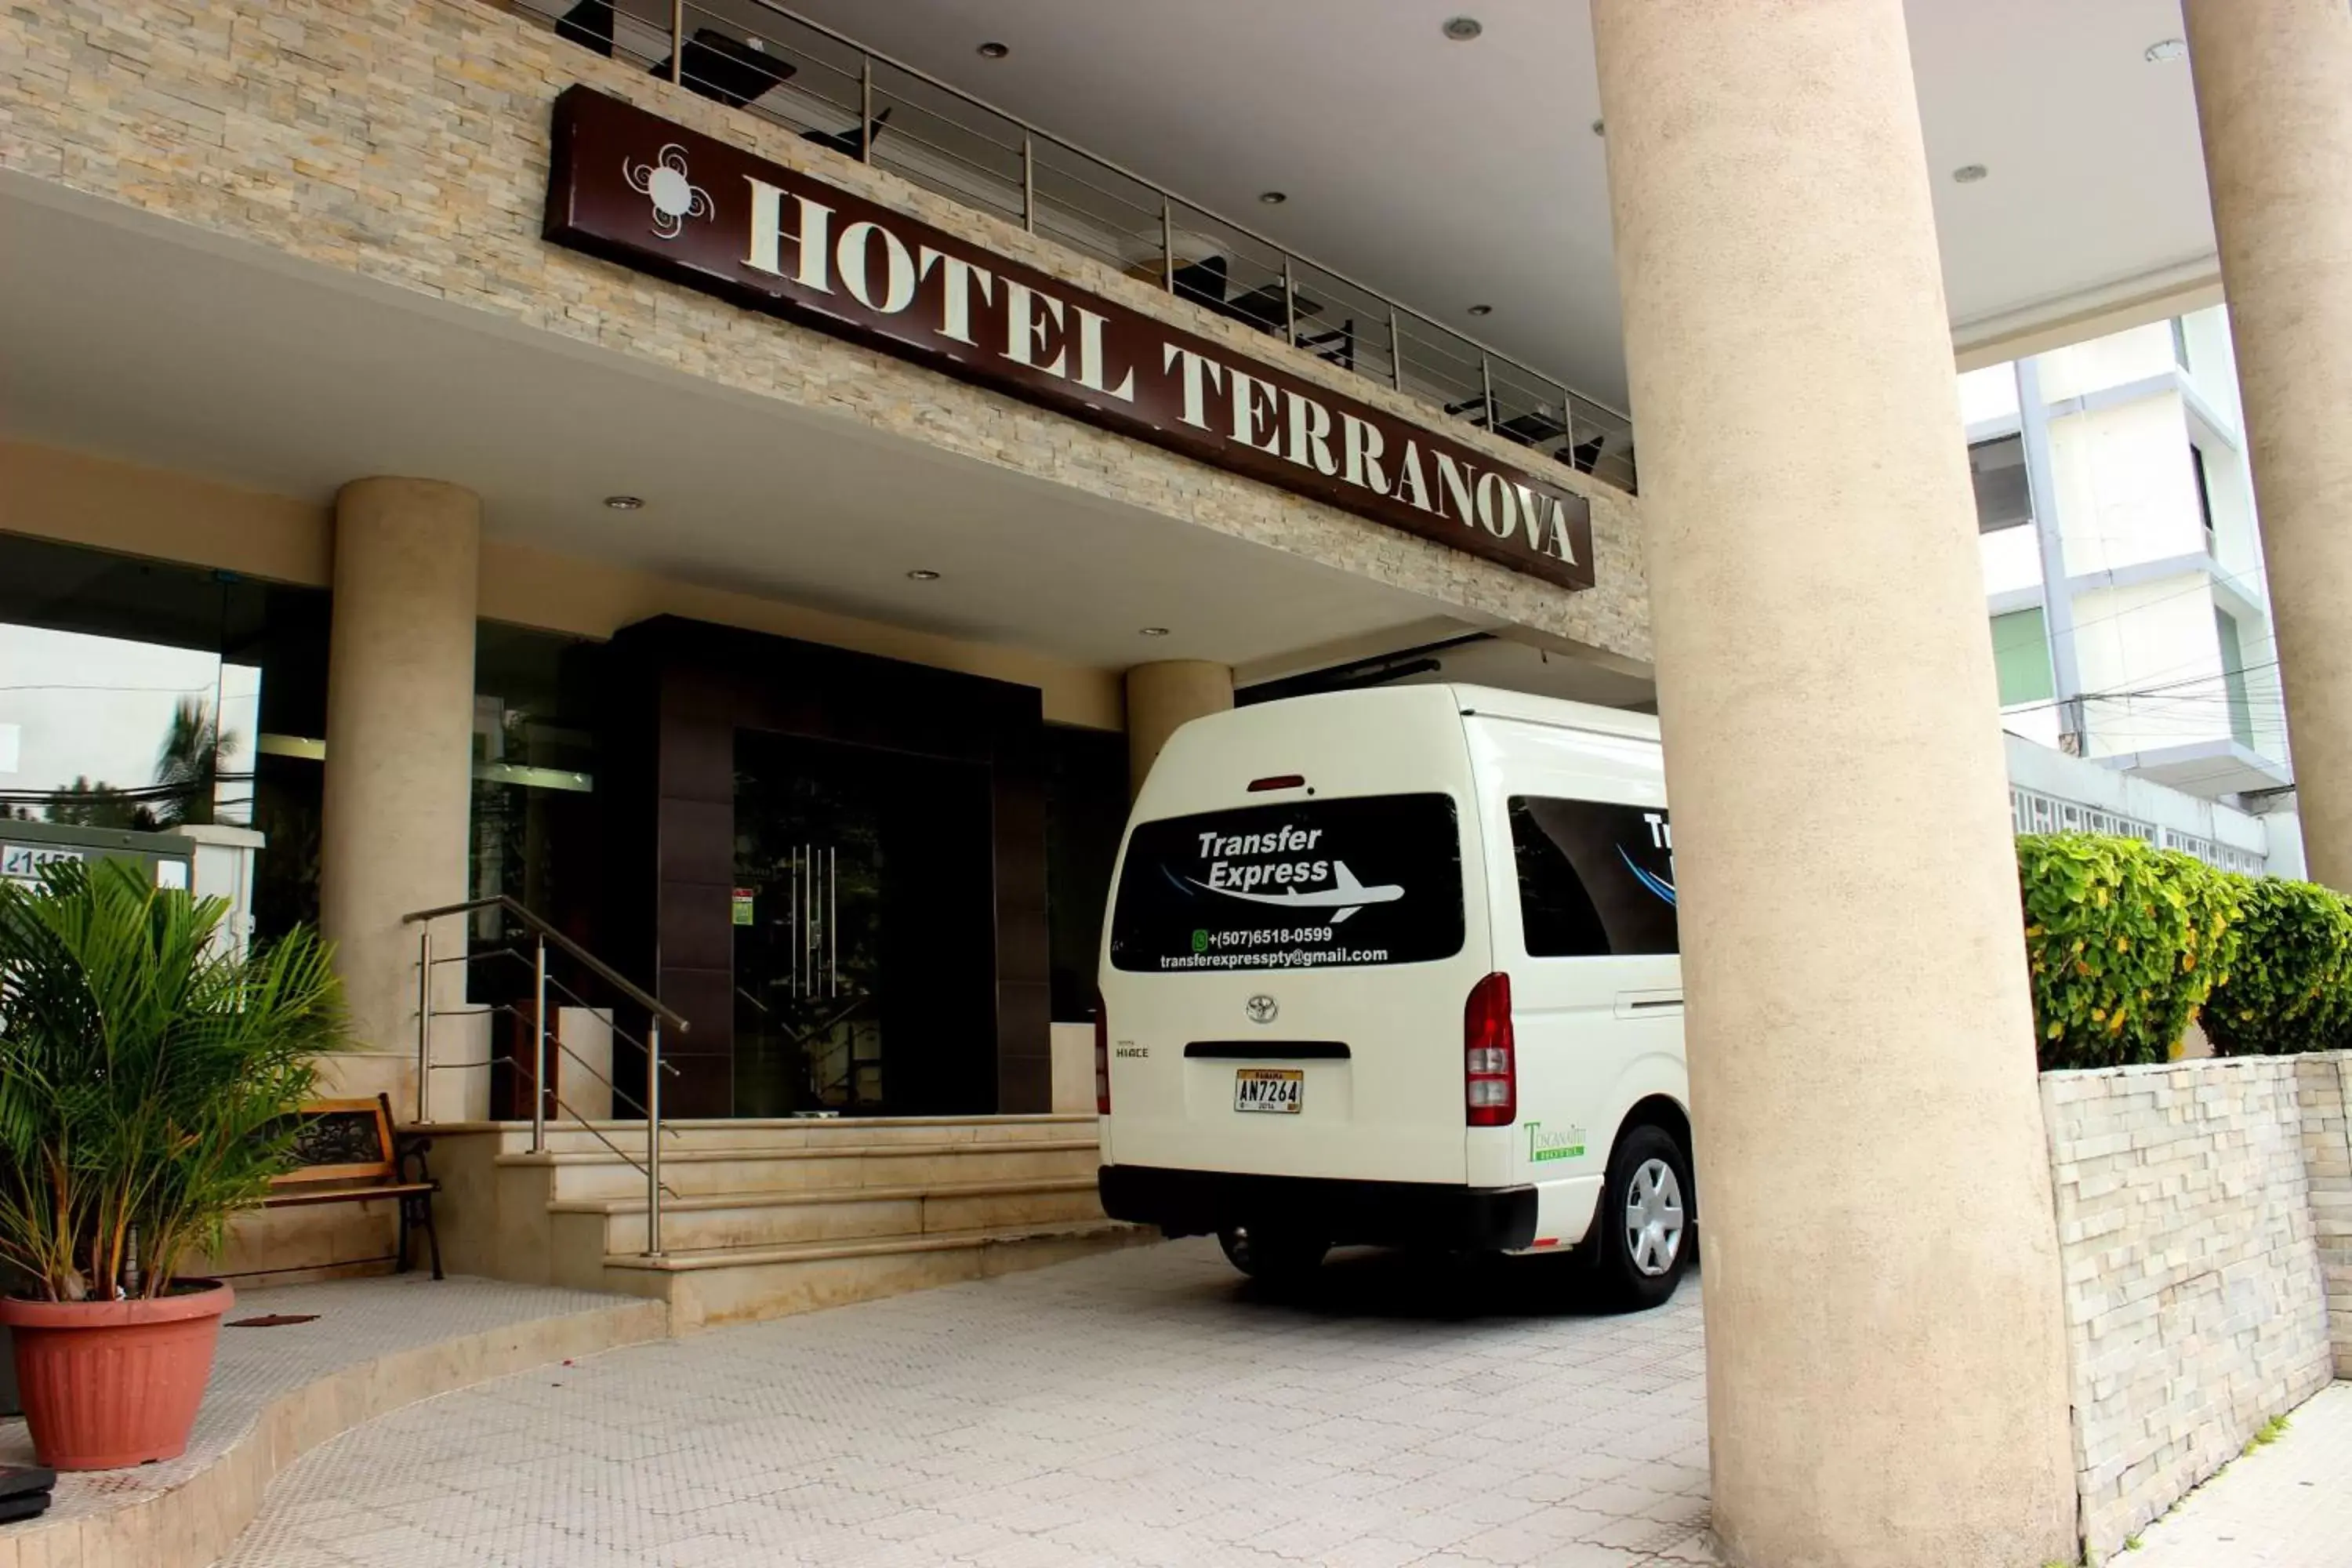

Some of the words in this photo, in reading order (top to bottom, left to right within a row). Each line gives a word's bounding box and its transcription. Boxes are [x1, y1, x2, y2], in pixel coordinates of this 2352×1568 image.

[739, 175, 1134, 402] HOTEL
[1163, 342, 1579, 566] TERRANOVA
[1199, 824, 1323, 858] Transfer
[1208, 860, 1329, 893] Express
[1160, 947, 1388, 970] transferexpresspty@gmail.com
[1116, 1047, 1149, 1058] HIACE
[1240, 1080, 1298, 1102] AN7264
